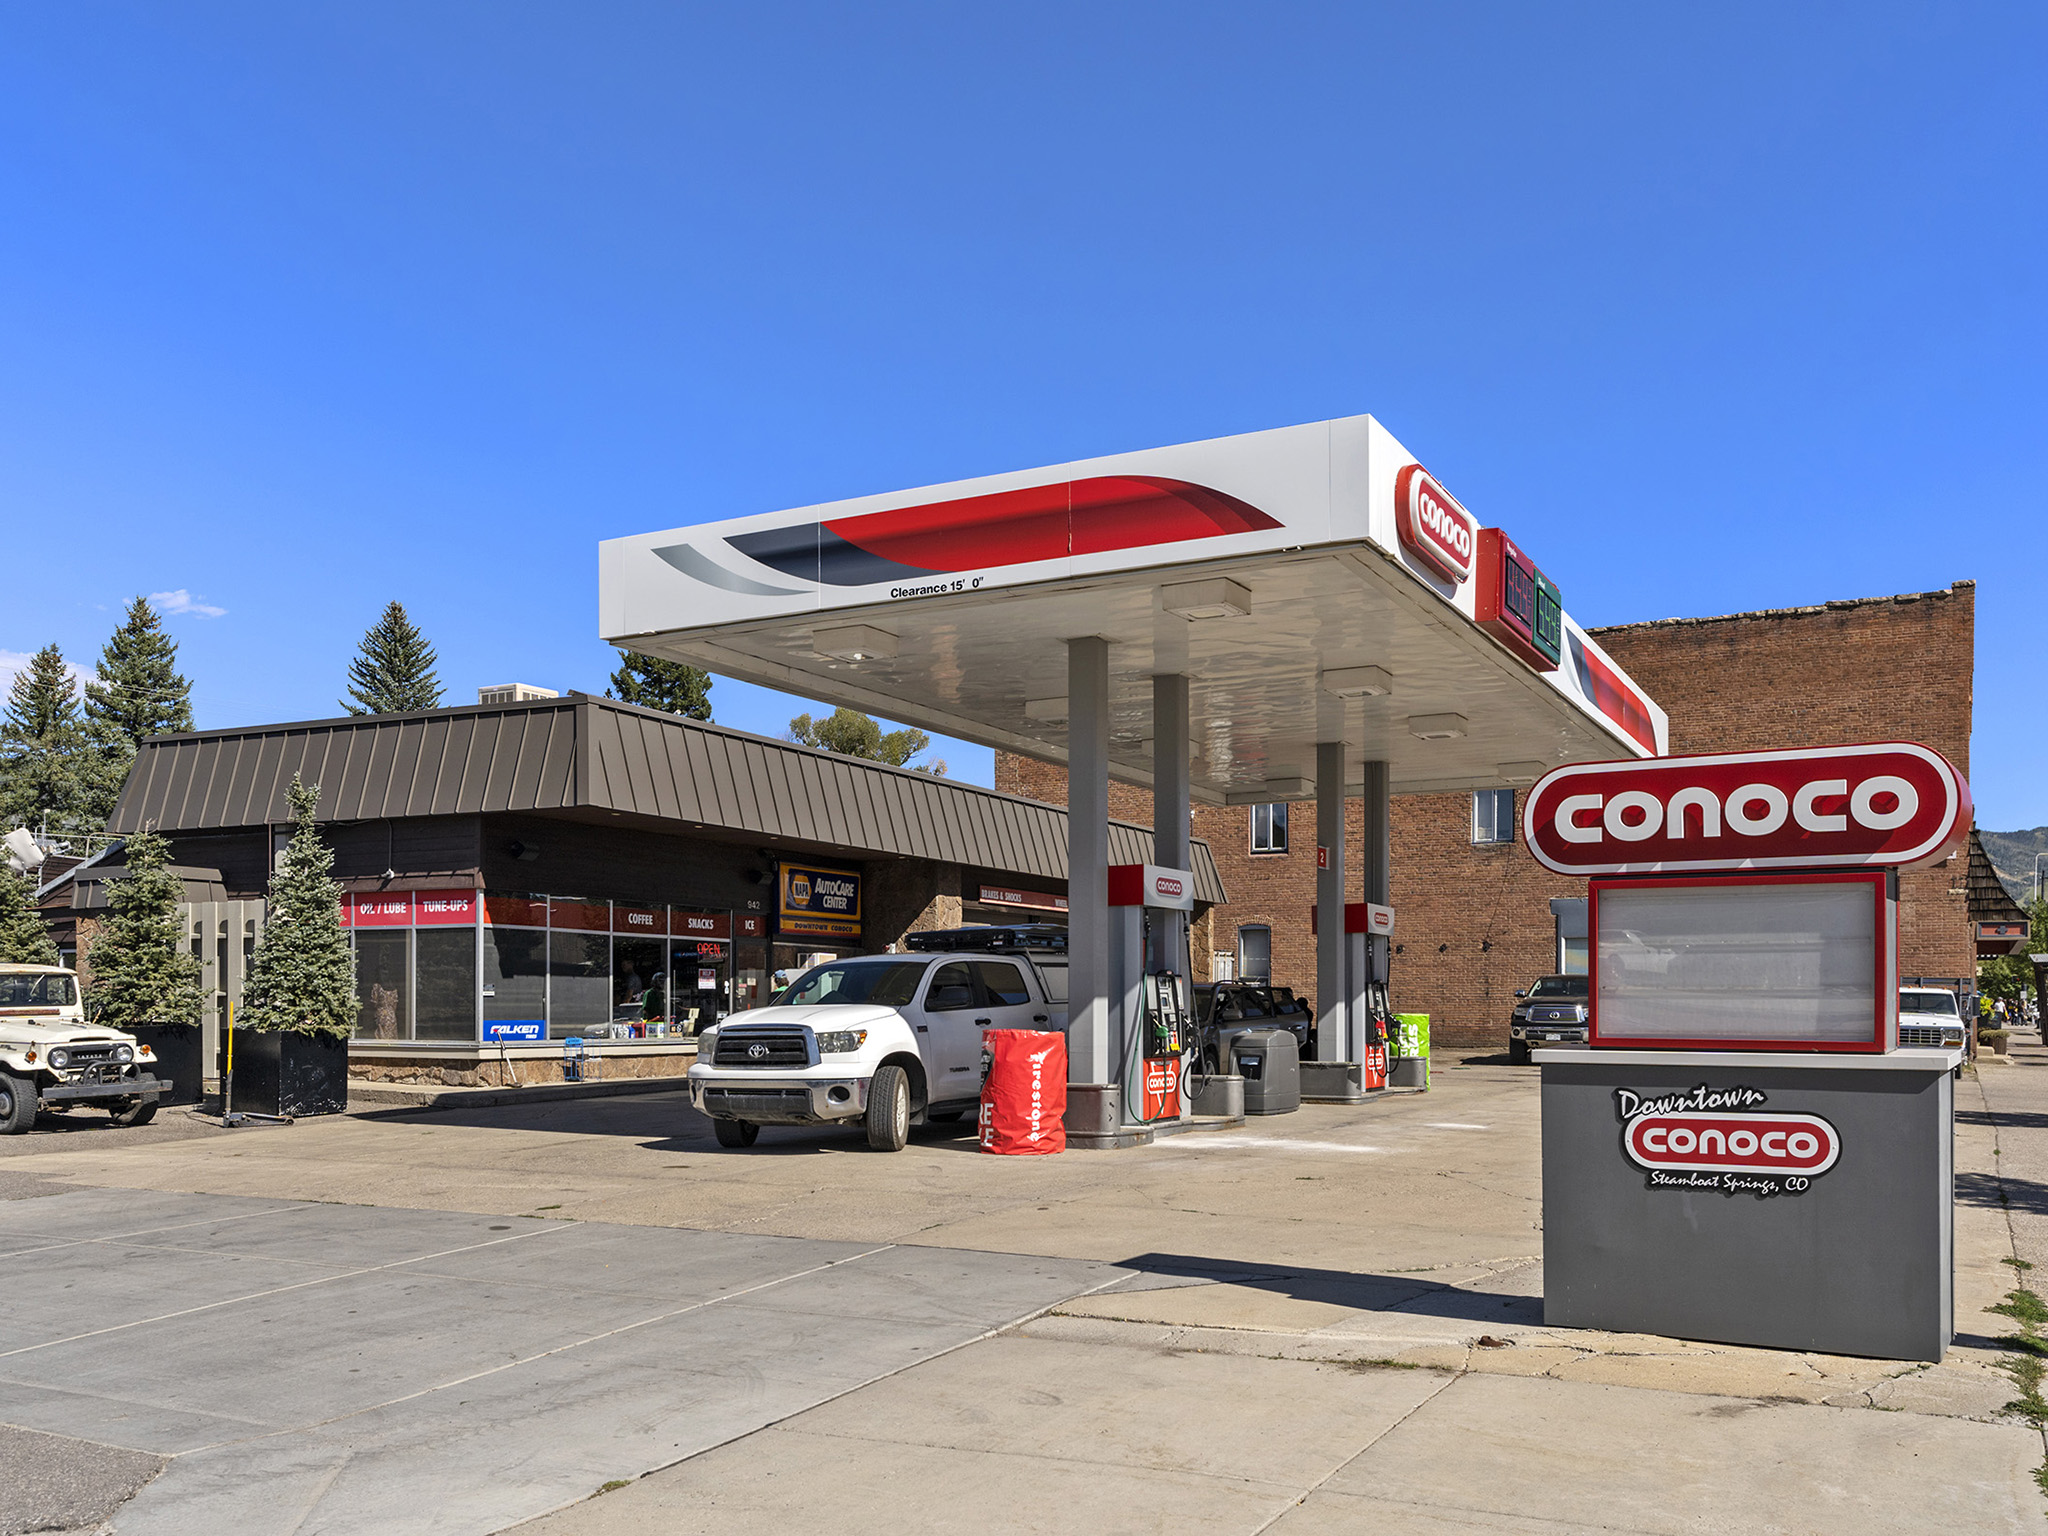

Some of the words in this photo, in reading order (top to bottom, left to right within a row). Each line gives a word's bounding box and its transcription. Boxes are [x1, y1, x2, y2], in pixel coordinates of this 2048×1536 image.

[890, 584, 947, 598] Clearance
[950, 579, 965, 591] 15'
[1320, 852, 1325, 863] 2
[981, 889, 999, 900] BRAKES
[1005, 892, 1022, 903] SHOCKS
[360, 903, 376, 914] OIL
[384, 902, 407, 914] LUBE
[423, 900, 468, 912] TUNE-UPS
[747, 901, 761, 910] 942
[823, 895, 848, 910] CENTER
[628, 913, 654, 926] COFFEE
[688, 918, 714, 930] SNACKS
[745, 920, 755, 930] ICE
[794, 922, 828, 931] DOWNTOWN
[831, 924, 853, 933] CONOCO
[697, 943, 721, 955] OPEN
[490, 1025, 540, 1034] FALKEN
[1618, 1086, 1764, 1118] Downtown
[1651, 1170, 1719, 1187] Steamboat
[1723, 1173, 1780, 1194] Springs,
[1785, 1176, 1809, 1191] CO
